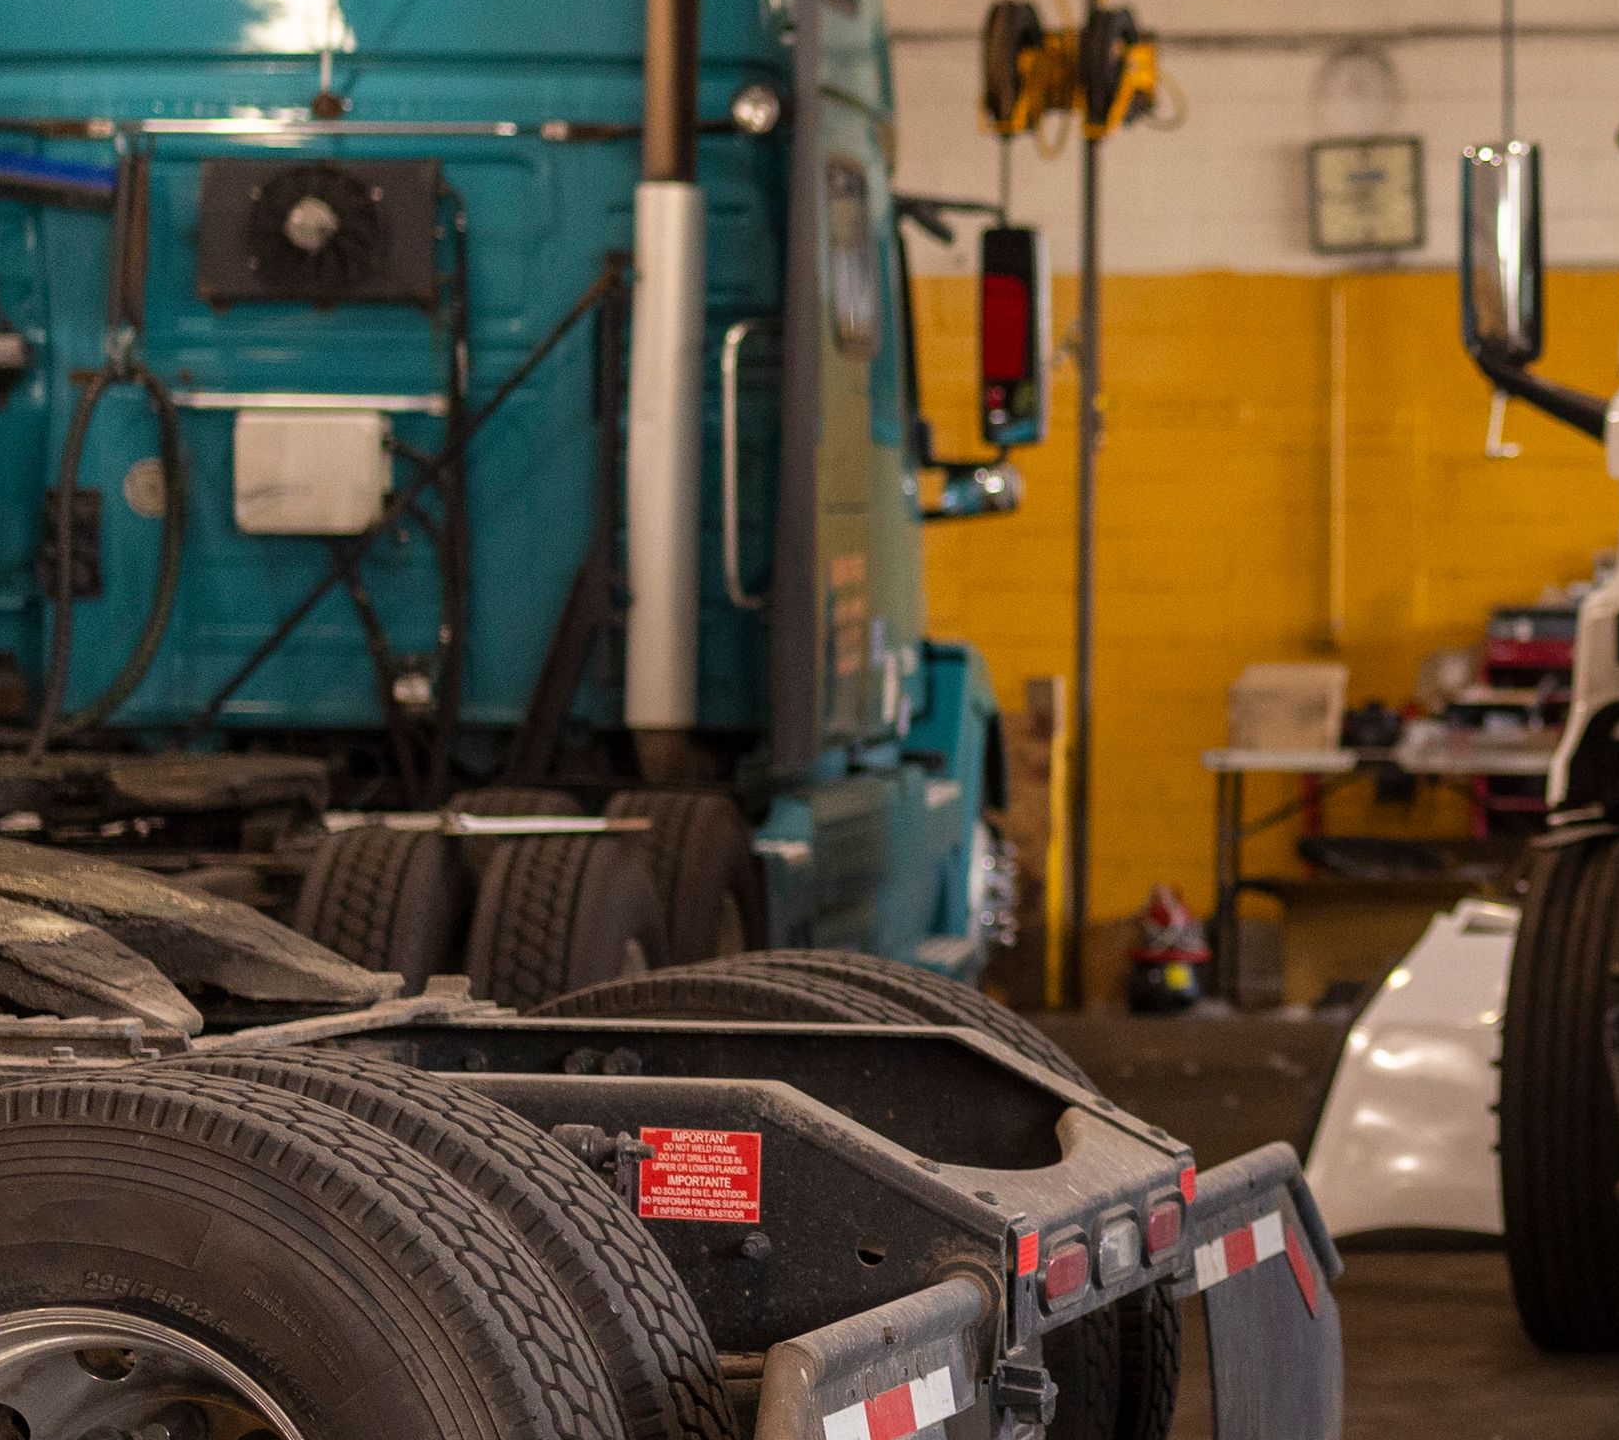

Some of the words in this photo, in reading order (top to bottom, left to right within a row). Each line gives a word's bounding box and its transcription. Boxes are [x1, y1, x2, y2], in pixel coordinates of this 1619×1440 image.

[672, 1132, 728, 1143] IMPORTANT
[663, 1143, 674, 1151] DO
[676, 1143, 690, 1152] NOT
[691, 1144, 711, 1153] WELD
[713, 1145, 737, 1154] FRAME
[658, 1153, 669, 1161] DO
[671, 1153, 685, 1162] NOT
[687, 1154, 706, 1163] DRILL
[709, 1155, 733, 1164] HOLES
[652, 1162, 676, 1171] UPPER
[677, 1163, 687, 1172] OR
[689, 1164, 715, 1173] LOWER
[716, 1165, 747, 1175] FLANGES
[667, 1175, 731, 1188] IMPORTANTE
[663, 1187, 690, 1196] SOLDAR
[692, 1188, 701, 1197] EN
[712, 1189, 747, 1199] BASTIDOR
[641, 1196, 651, 1204] NO
[722, 1199, 757, 1209] SUPERIOR
[653, 1206, 658, 1214] E
[694, 1208, 707, 1217] DEL
[709, 1209, 744, 1219] BASTIDOR
